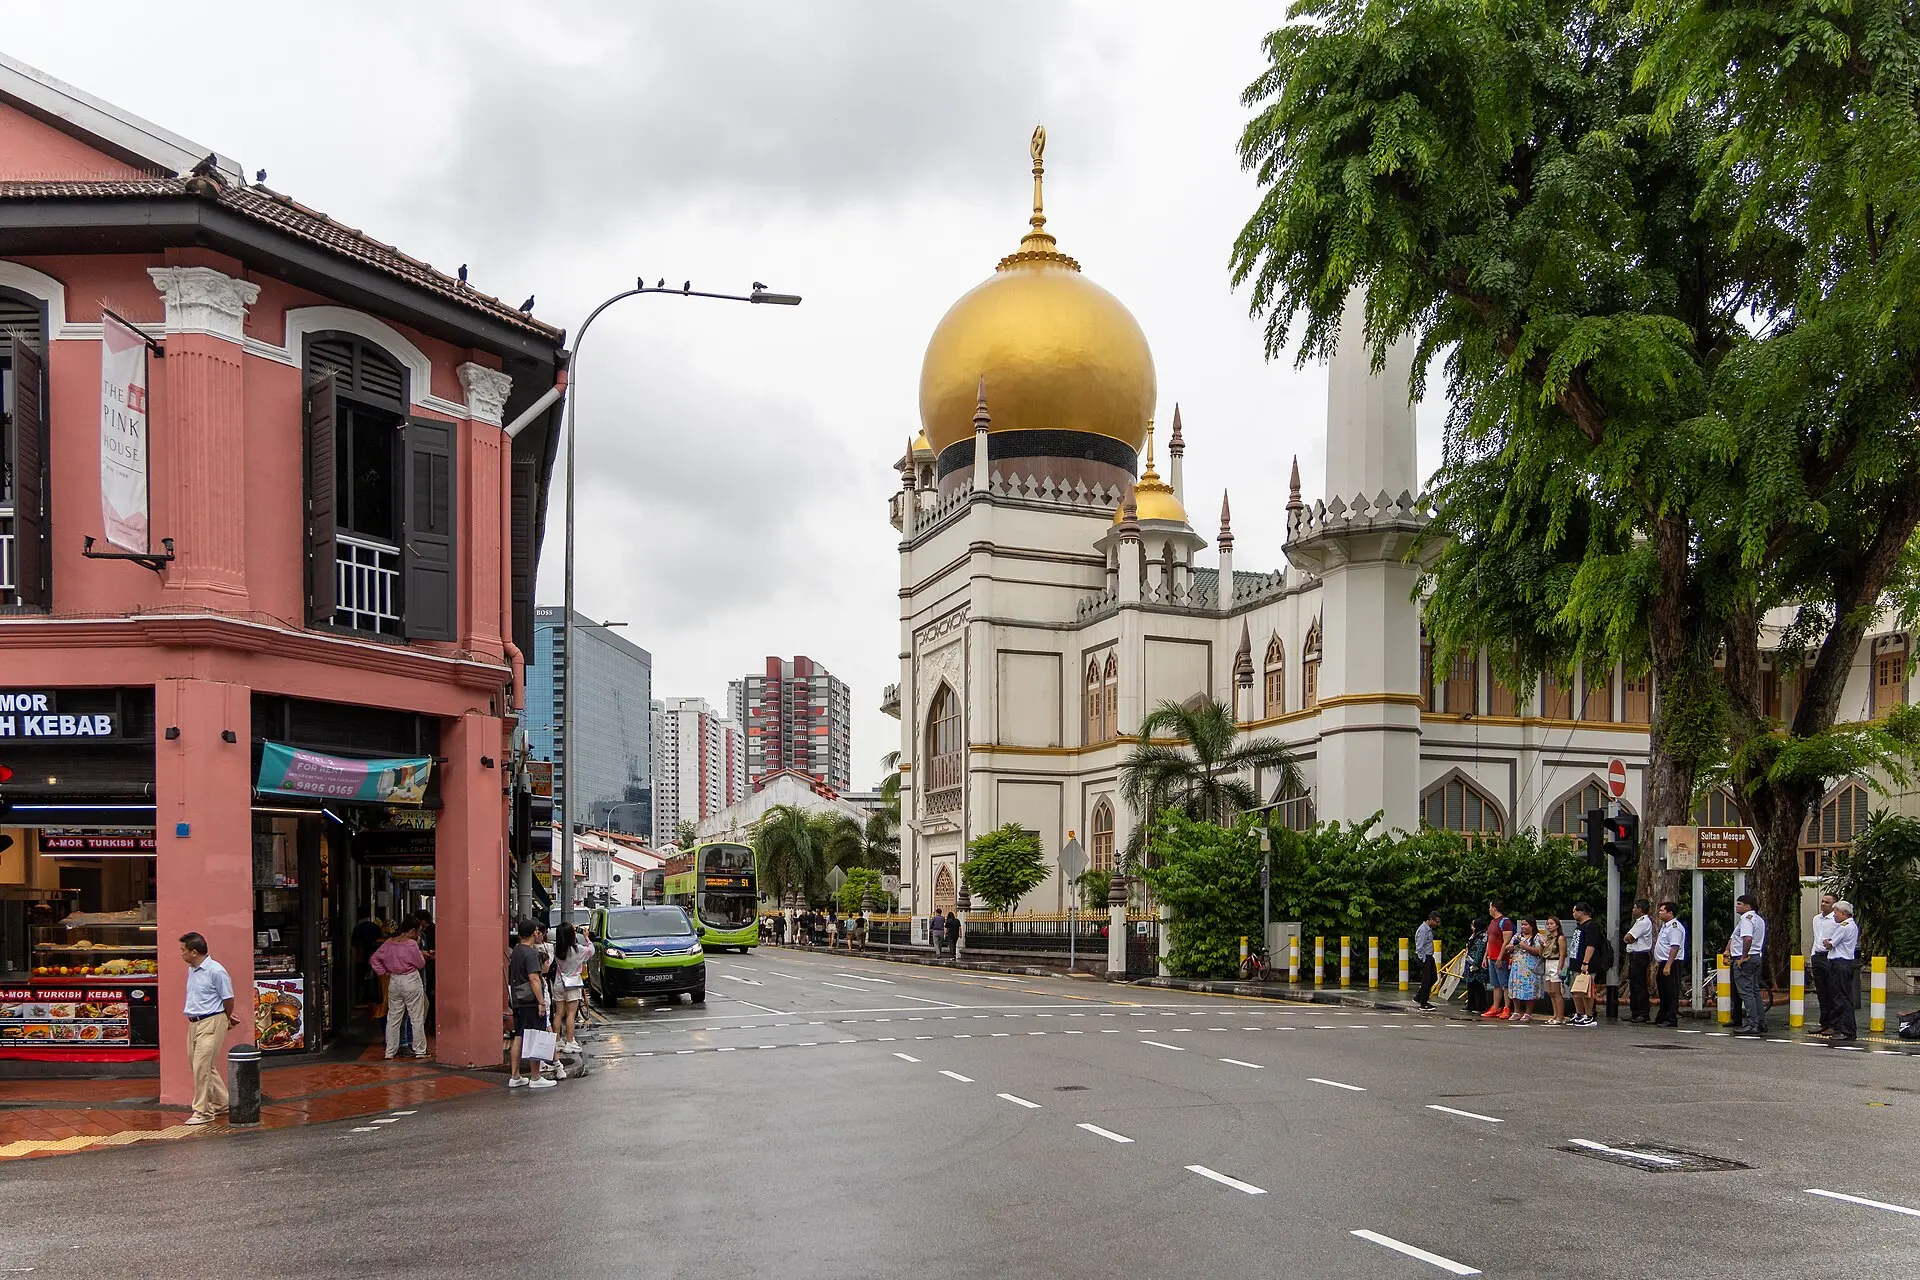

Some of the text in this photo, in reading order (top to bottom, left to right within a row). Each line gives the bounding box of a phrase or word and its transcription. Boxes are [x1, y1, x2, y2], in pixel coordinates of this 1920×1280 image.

[103, 380, 124, 404] THE
[104, 404, 140, 438] PINK
[103, 434, 139, 462] HOUSE
[0, 694, 48, 711] MOR
[24, 715, 112, 736] KEBAB
[297, 762, 345, 775] FOR RENT
[296, 781, 326, 793] 9825
[328, 784, 354, 795] 0165
[48, 839, 83, 847] A-MOR
[89, 839, 134, 847] TURKISH
[1701, 831, 1746, 842] Sultan Mosque
[741, 878, 749, 887] 51
